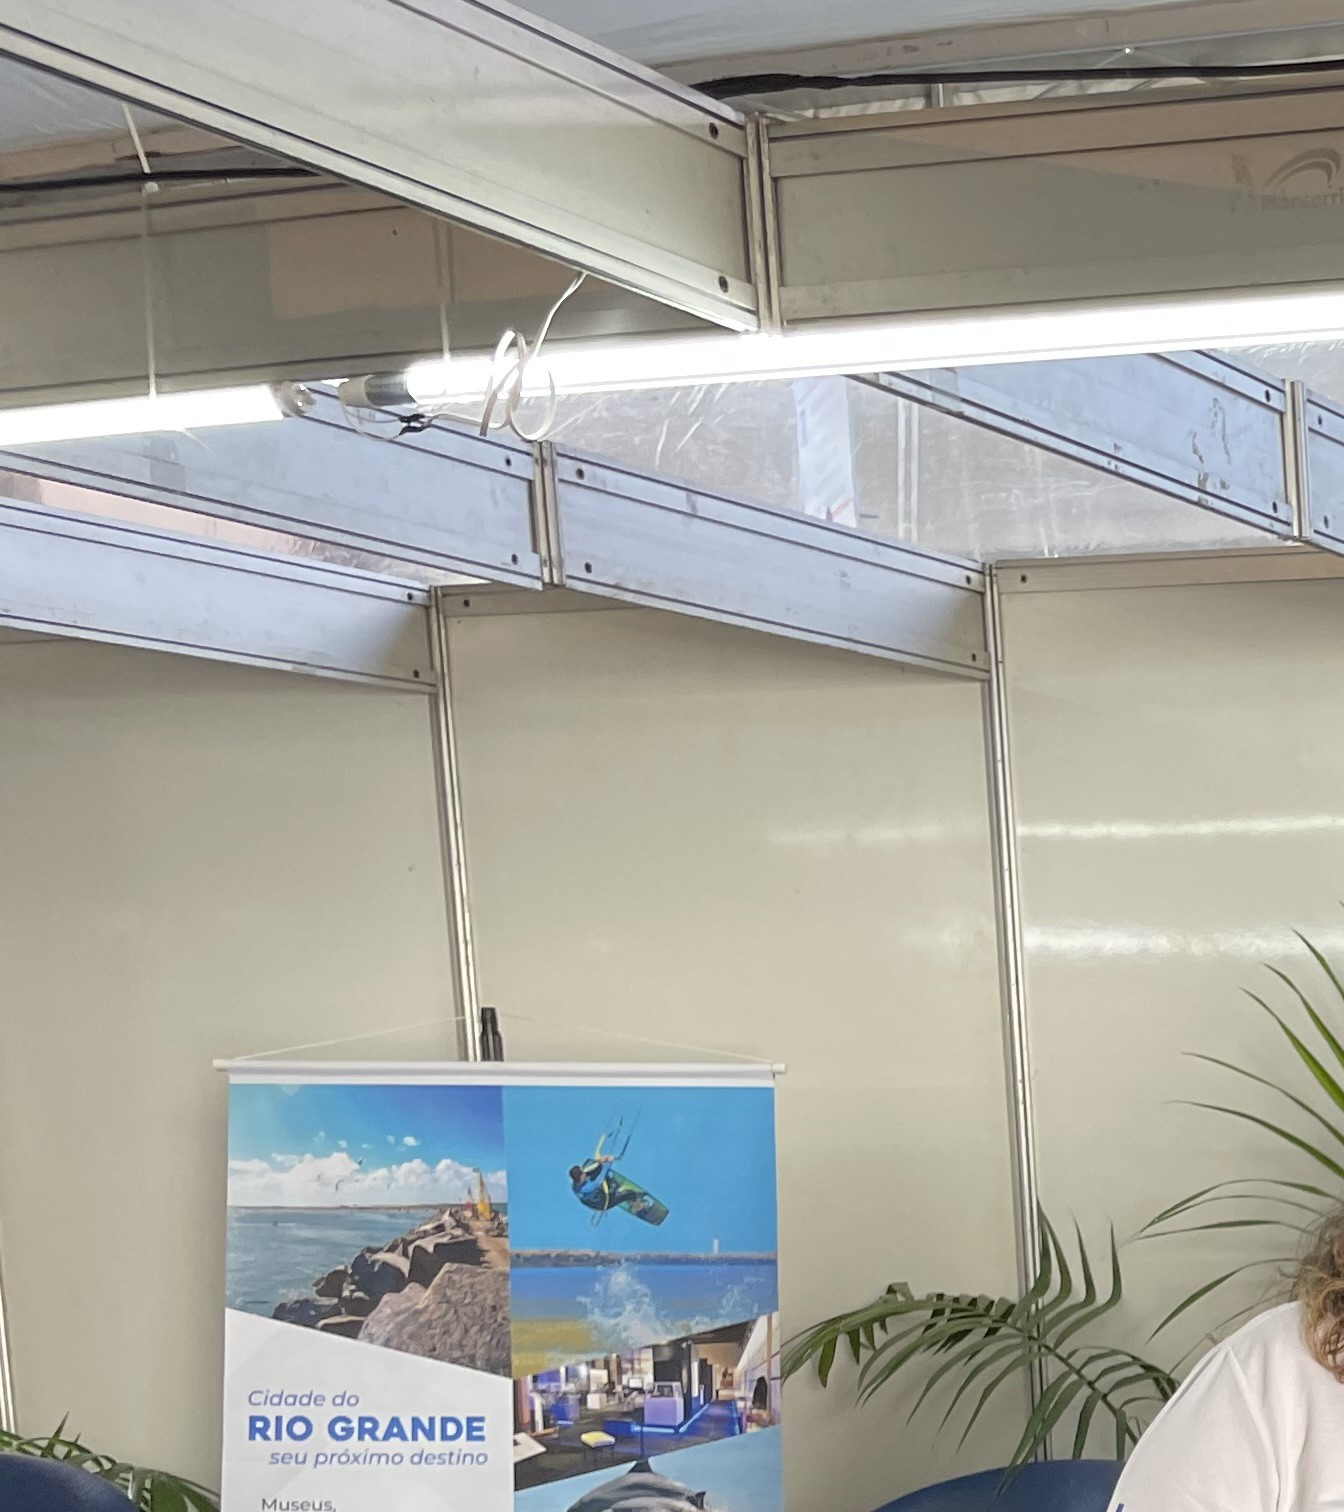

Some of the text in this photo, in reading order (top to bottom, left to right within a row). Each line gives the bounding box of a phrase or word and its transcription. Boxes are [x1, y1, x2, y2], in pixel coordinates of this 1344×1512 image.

[248, 1390, 360, 1407] Cidade do
[248, 1415, 487, 1442] RIO GRANDE
[269, 1448, 489, 1469] seu próximo destino
